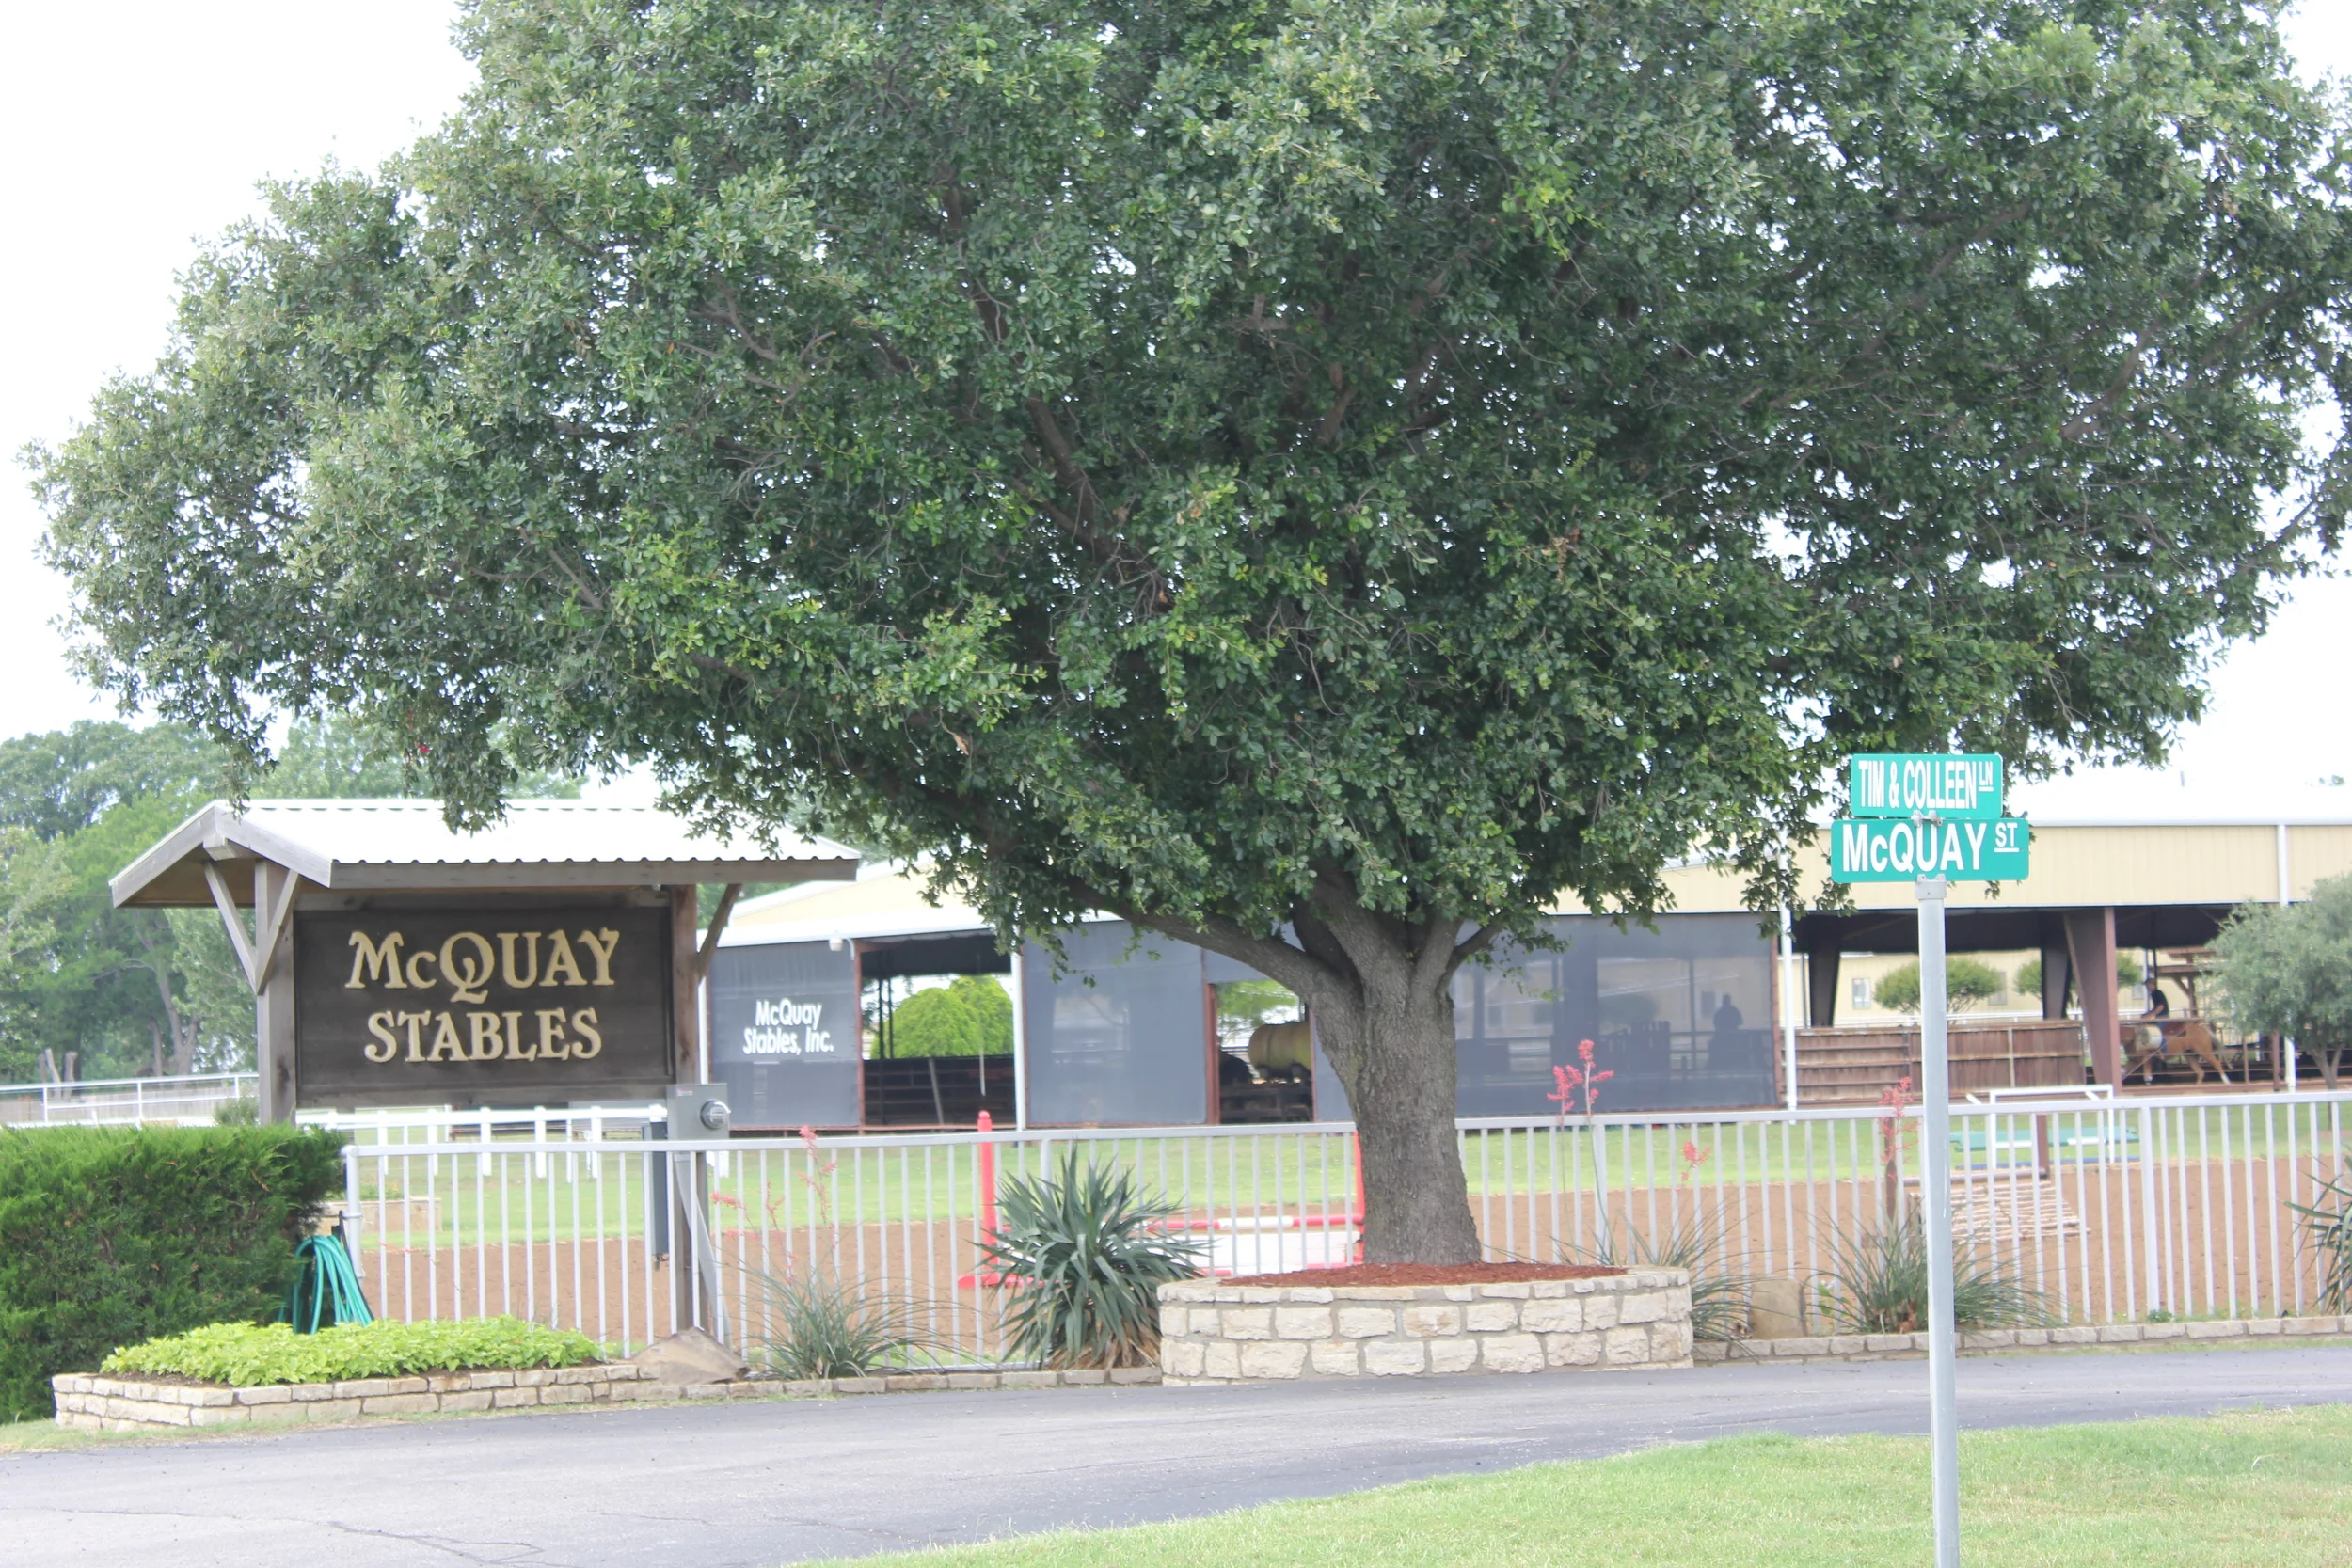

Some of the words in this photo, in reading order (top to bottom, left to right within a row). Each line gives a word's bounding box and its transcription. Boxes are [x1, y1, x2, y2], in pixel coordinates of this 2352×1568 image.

[1858, 760, 1885, 808] TIM
[1888, 760, 1900, 809] &
[1903, 760, 1977, 809] COLLEEN
[1979, 760, 1994, 786] LN
[1842, 822, 1987, 873] McQUAY
[1994, 822, 2018, 847] ST
[344, 927, 620, 1004] McQUAY
[364, 1007, 602, 1063] STABLES
[755, 997, 823, 1030] McQuay
[742, 1027, 802, 1055] Stables,
[805, 1026, 834, 1053] Inc.
